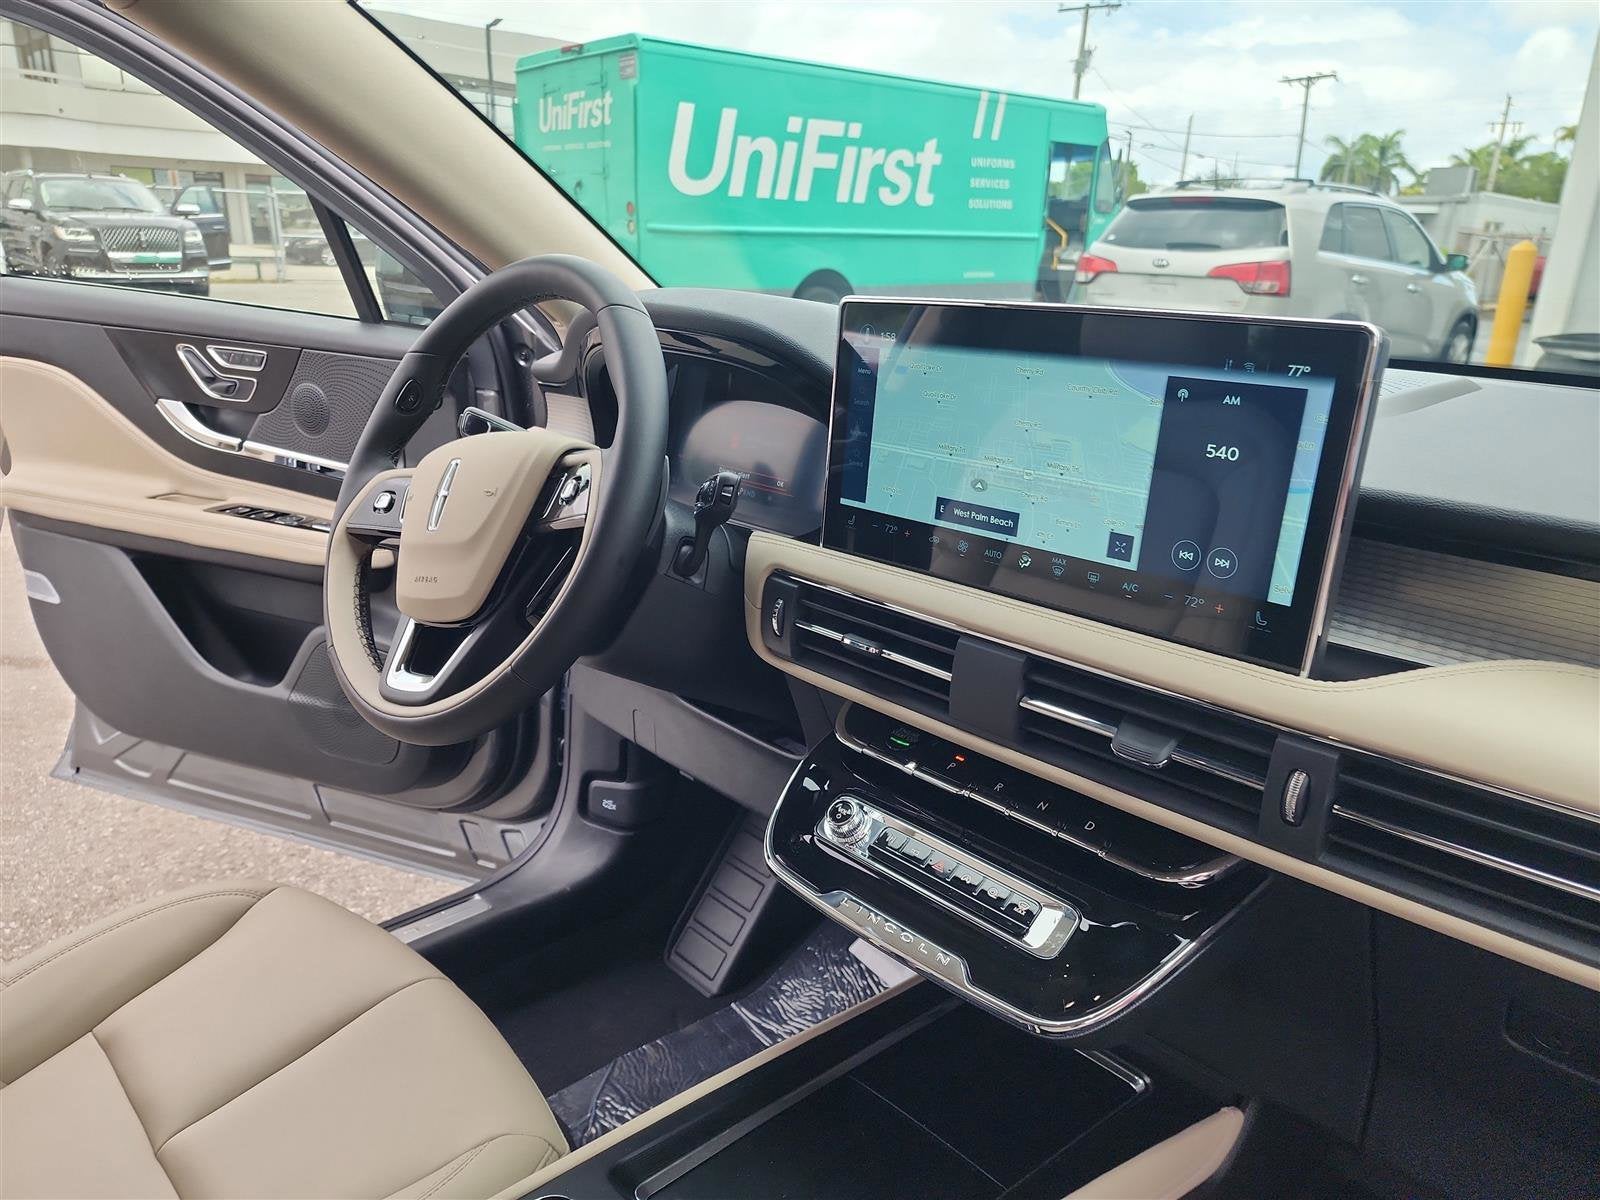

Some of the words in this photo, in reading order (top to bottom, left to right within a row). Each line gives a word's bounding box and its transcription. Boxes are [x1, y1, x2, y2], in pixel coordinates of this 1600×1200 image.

[539, 90, 613, 133] UniFirst
[668, 101, 942, 206] UniFirst
[970, 157, 1016, 169] UNIFORMS
[969, 178, 1010, 190] SERVICES
[968, 198, 1014, 210] SOLUTIONS
[1223, 395, 1241, 405] AM
[1205, 443, 1240, 461] 540
[940, 504, 945, 513] E
[953, 507, 970, 518] West
[970, 511, 988, 522] Palm
[989, 514, 1014, 528] Beach
[984, 549, 1002, 559] AUTO
[1052, 557, 1066, 566] MAX
[1122, 582, 1139, 593] A/C
[946, 762, 956, 770] P
[994, 782, 1004, 792] R
[1037, 801, 1049, 811] N
[1085, 820, 1095, 831] D
[840, 897, 951, 966] LINCOLN
